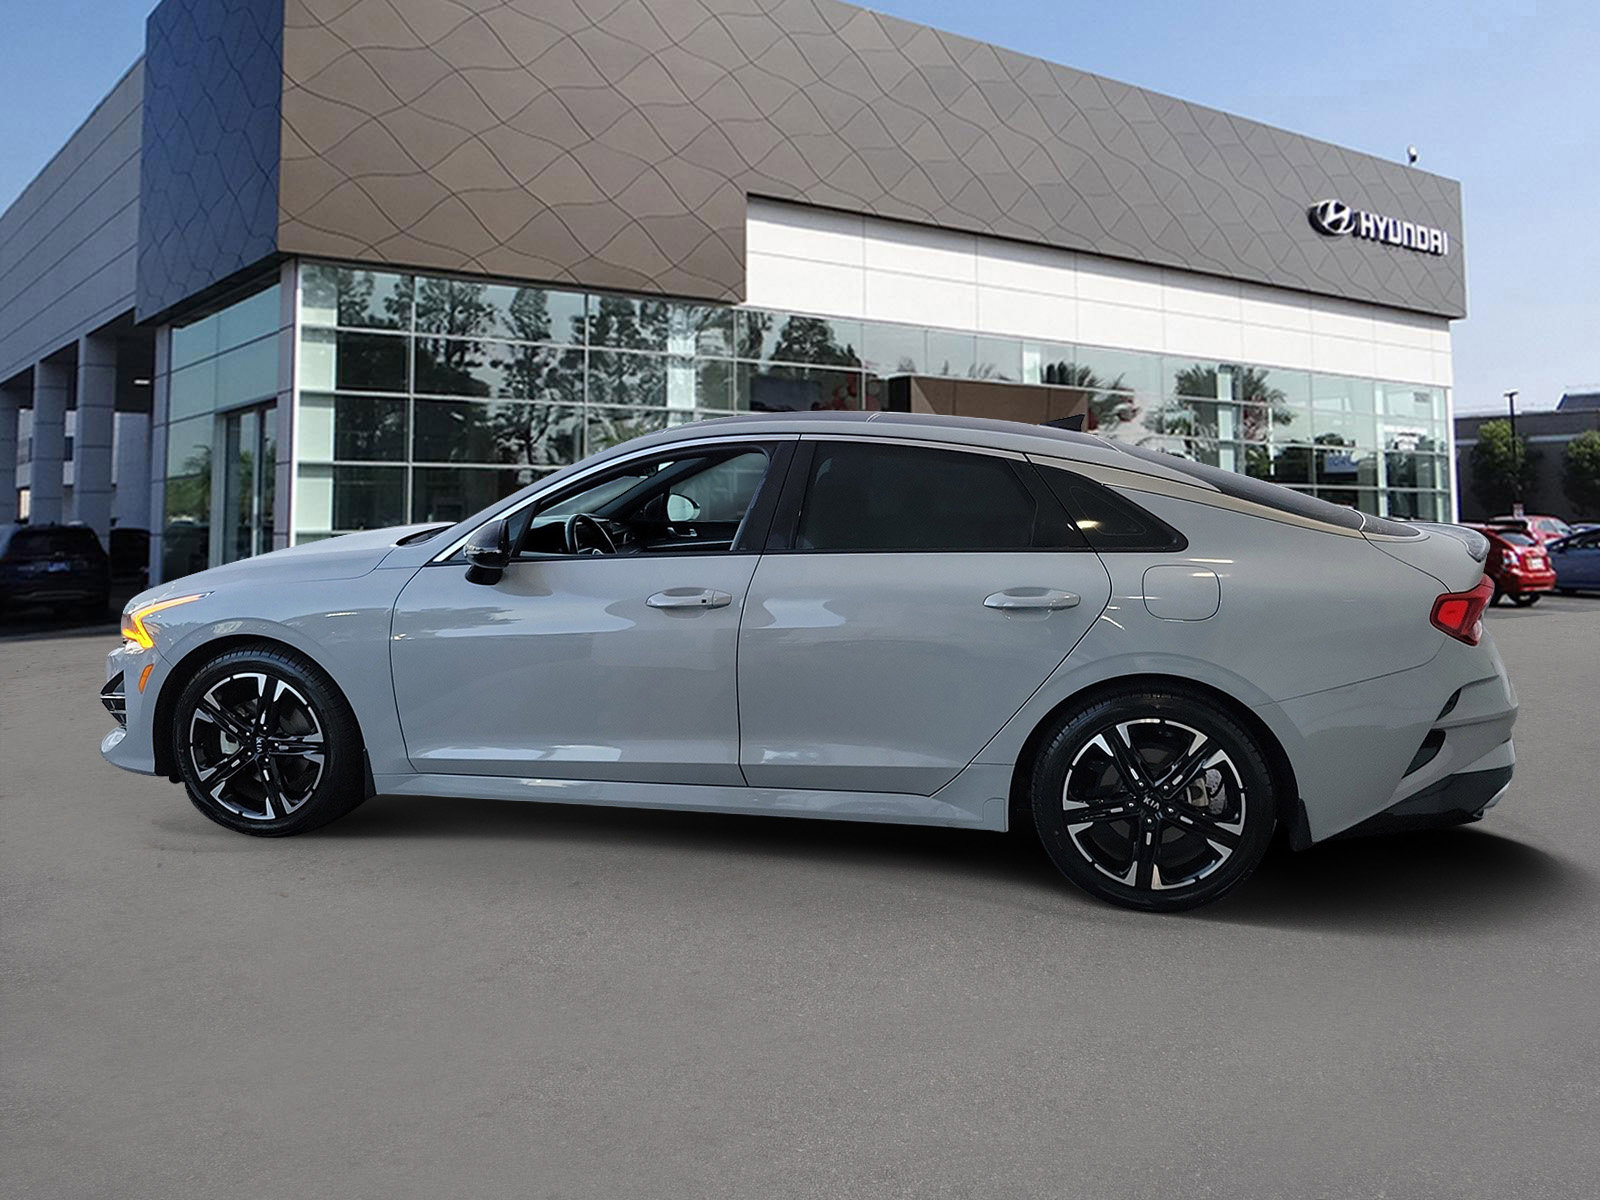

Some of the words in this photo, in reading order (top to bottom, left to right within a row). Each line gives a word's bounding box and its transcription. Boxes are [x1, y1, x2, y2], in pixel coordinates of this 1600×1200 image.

[1360, 210, 1448, 255] HYUNDAI
[255, 736, 263, 753] KIA
[1143, 796, 1160, 810] KIA
